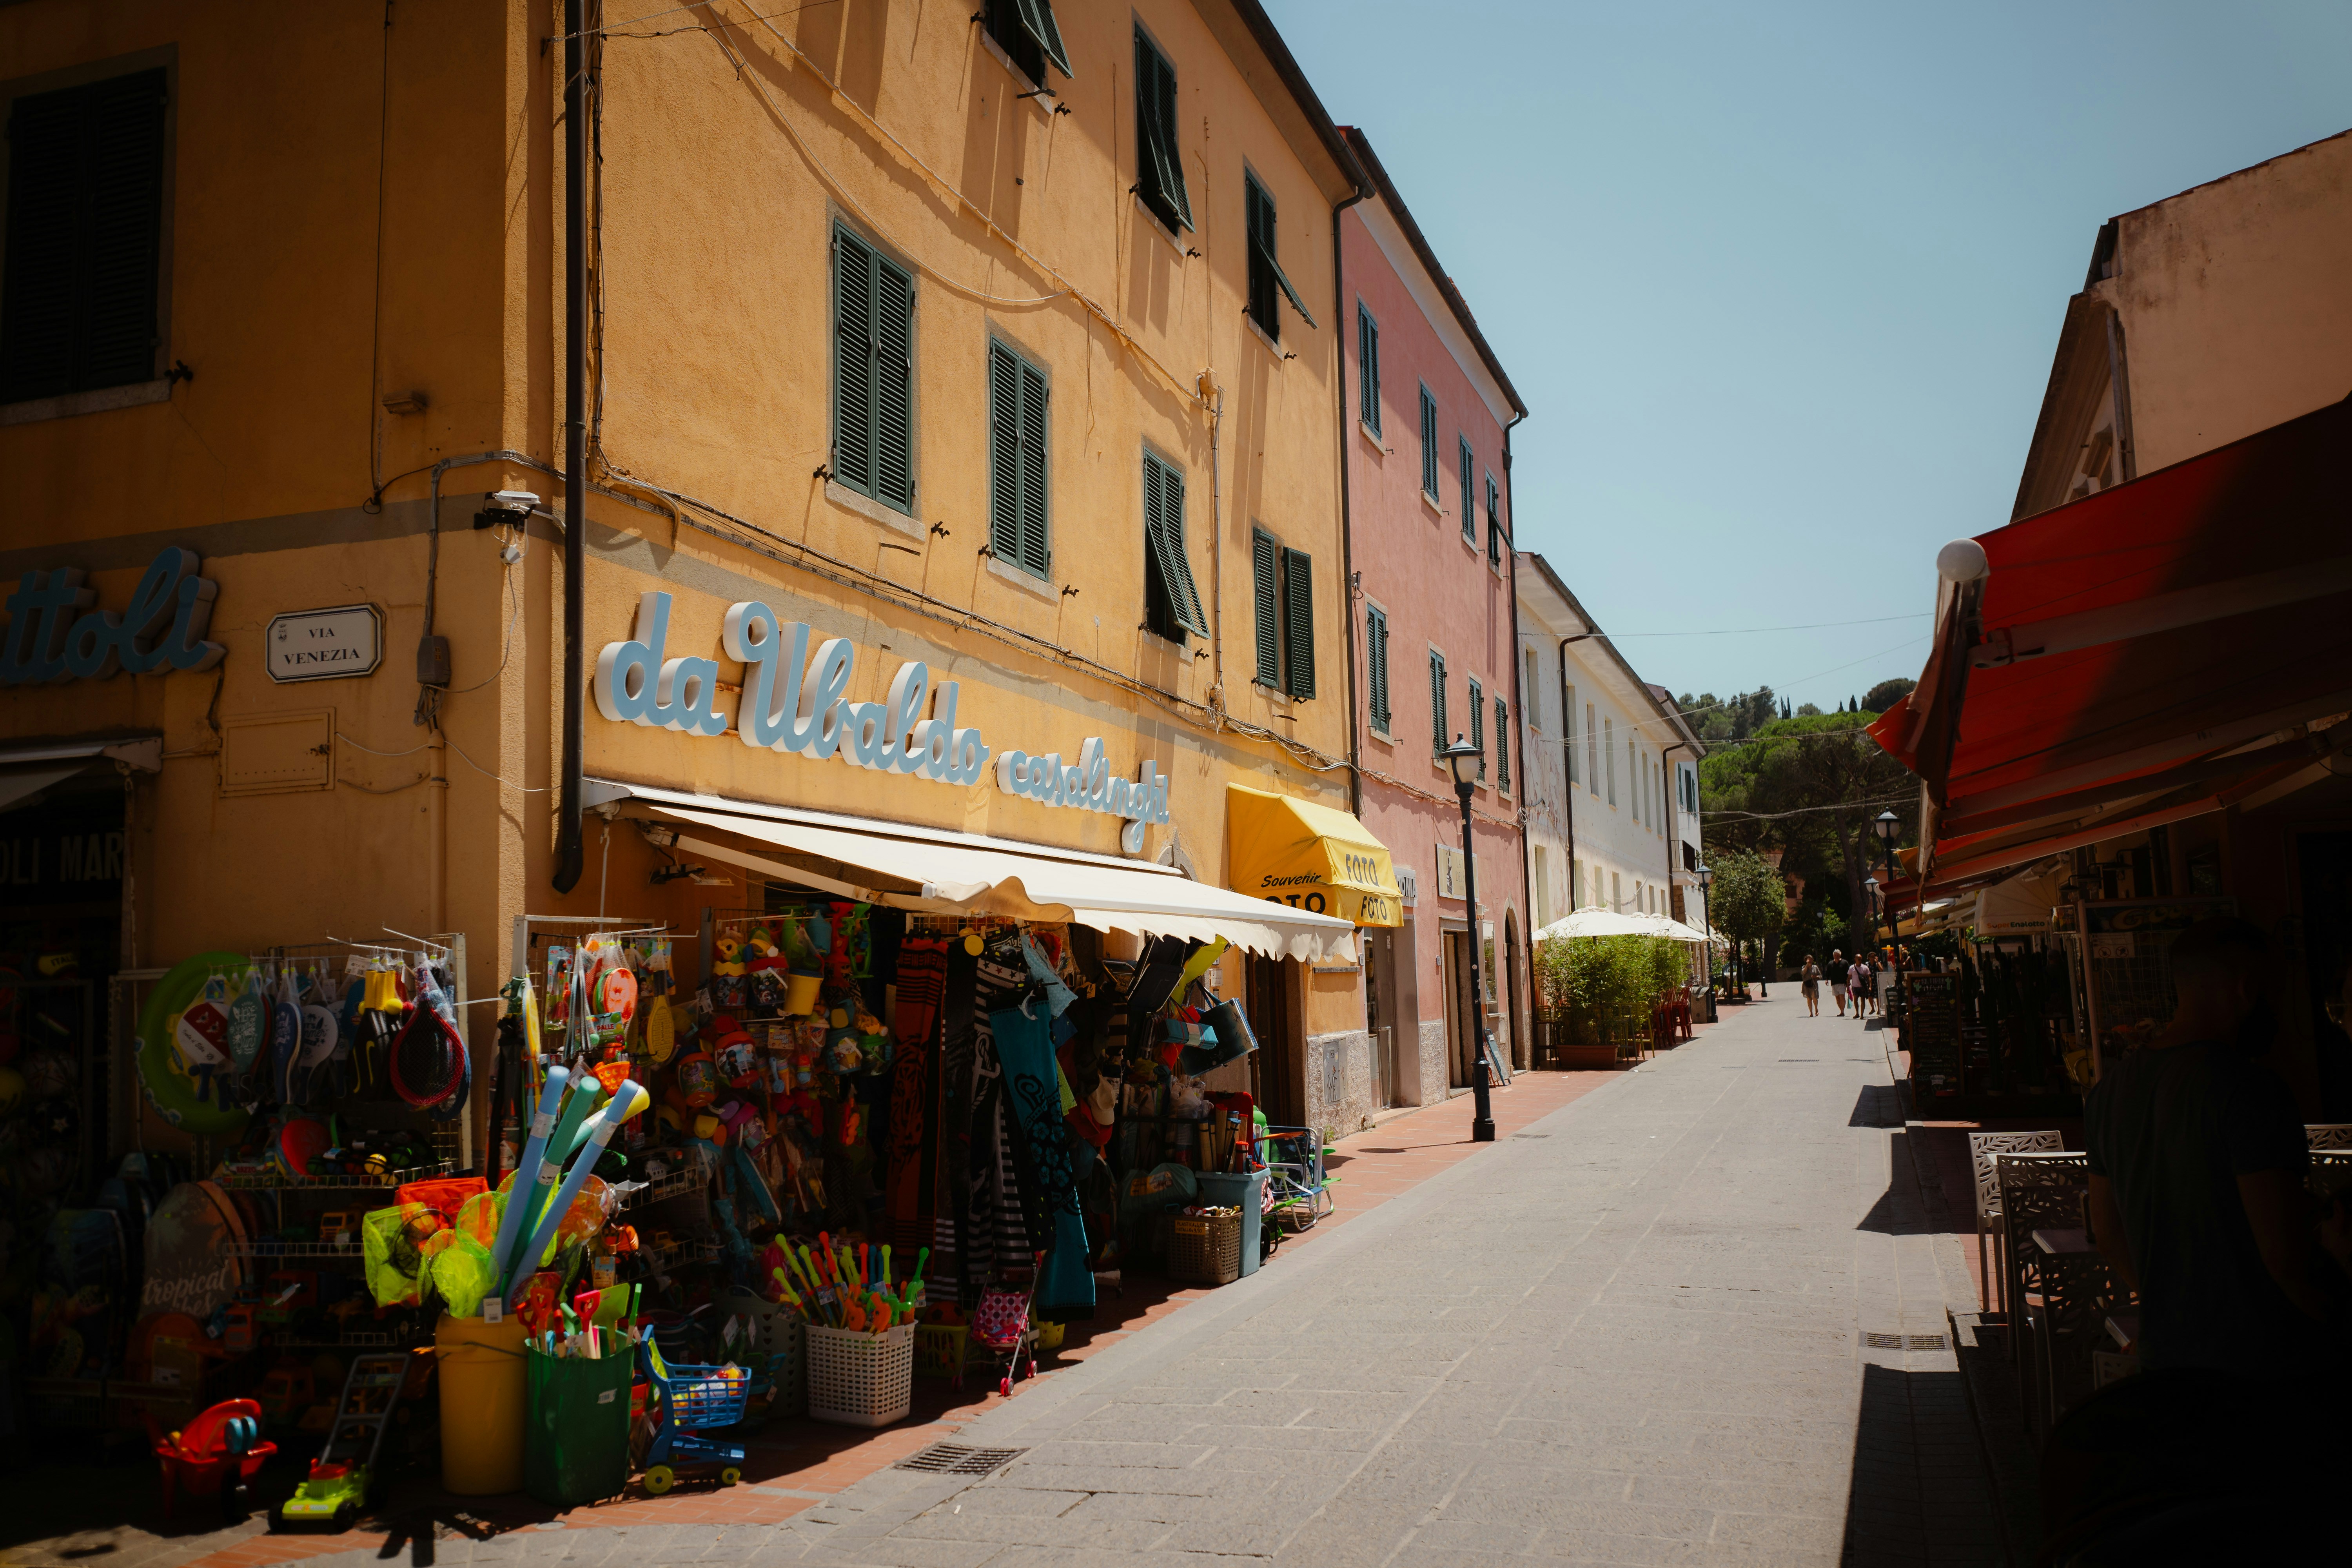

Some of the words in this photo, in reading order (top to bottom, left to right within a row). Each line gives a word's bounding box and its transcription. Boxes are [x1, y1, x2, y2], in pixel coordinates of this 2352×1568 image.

[0, 546, 227, 687] ttoli
[309, 628, 335, 639] VIA
[284, 648, 360, 665] VENEZIA
[593, 591, 728, 736] da
[722, 601, 990, 786] Ubaldo
[997, 737, 1169, 853] casalinghi
[1261, 872, 1322, 888] Souvenir
[1346, 853, 1380, 887] FOTO
[1264, 892, 1327, 915] TO
[1360, 895, 1388, 921] FOTO
[141, 1259, 229, 1308] tropical
